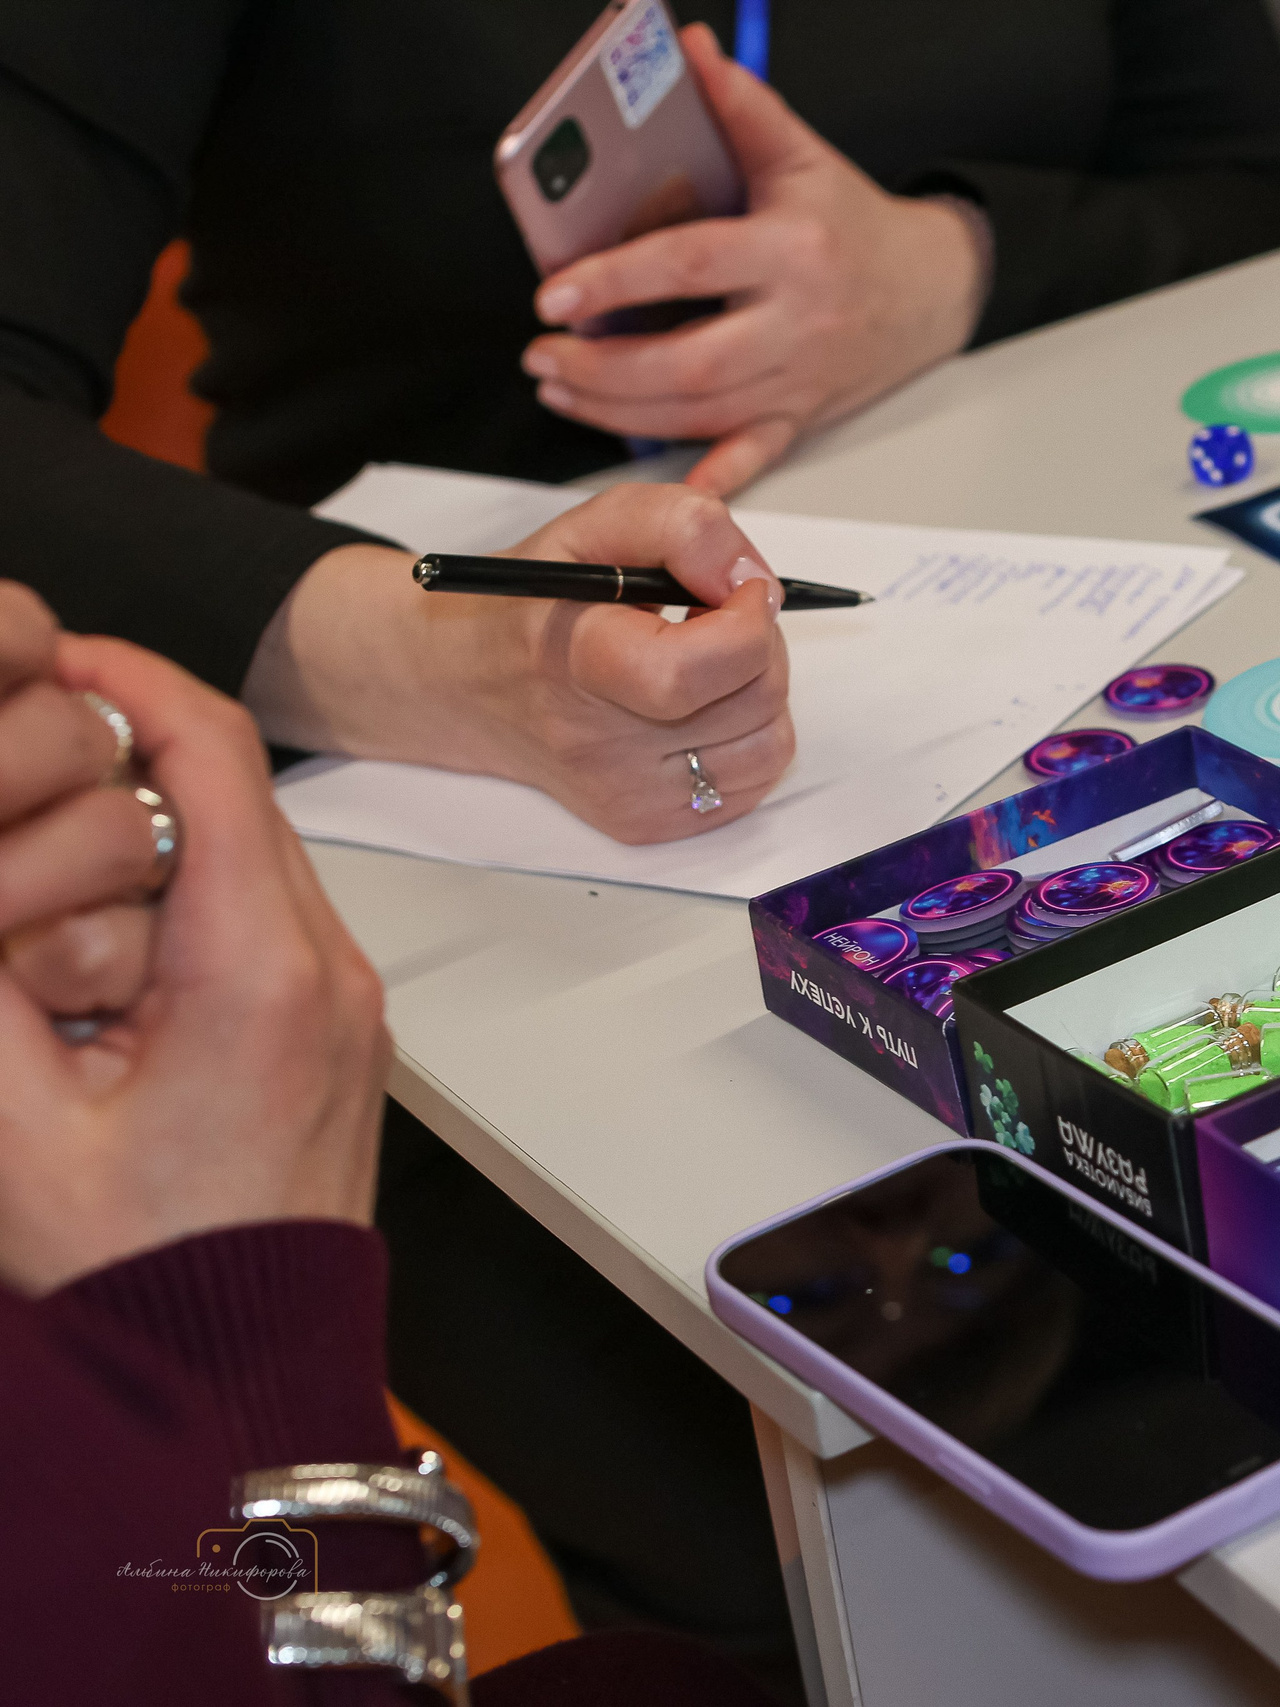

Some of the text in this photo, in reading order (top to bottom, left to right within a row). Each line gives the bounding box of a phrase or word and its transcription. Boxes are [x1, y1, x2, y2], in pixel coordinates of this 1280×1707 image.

[823, 931, 880, 966] НЕЙРОН
[790, 970, 919, 1069] ПУТЬ К УСПЕХУ
[1057, 1115, 1148, 1195] РАЗУМА
[1063, 1146, 1153, 1217] БИБЛИОТЕКА
